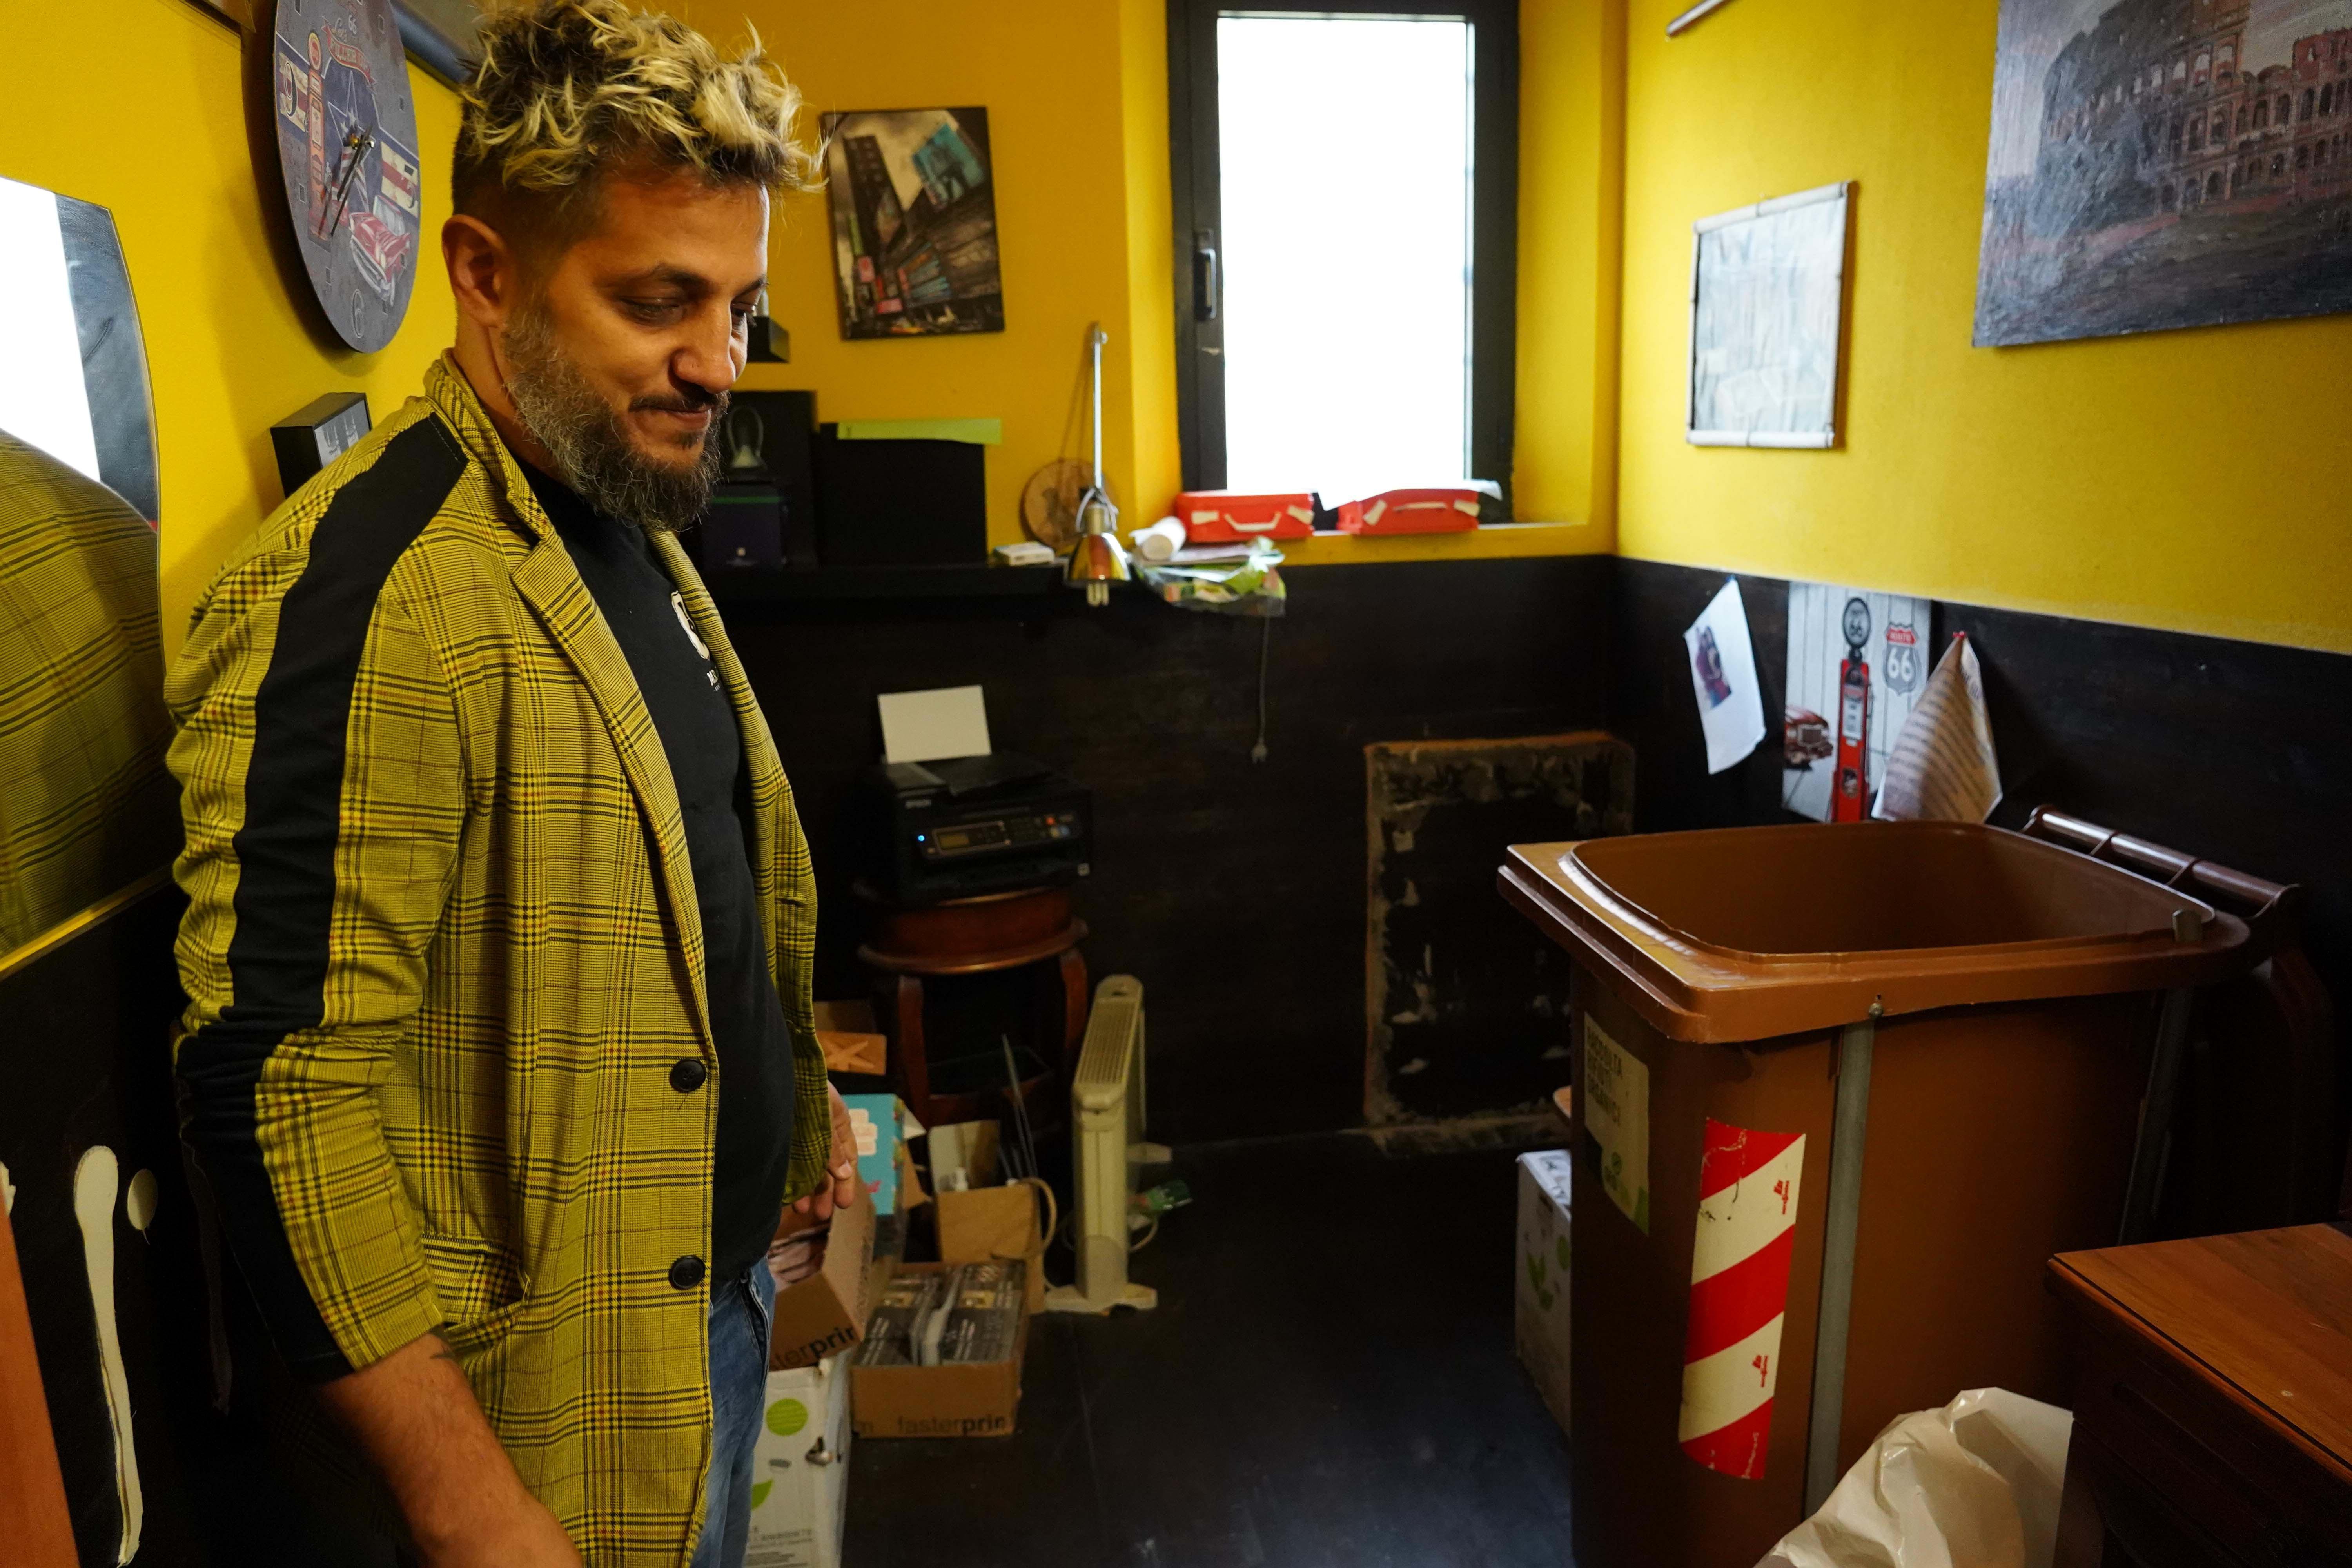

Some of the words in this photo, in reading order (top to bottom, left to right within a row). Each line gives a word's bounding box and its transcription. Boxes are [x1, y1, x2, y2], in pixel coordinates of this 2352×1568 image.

[348, 14, 357, 35] 66
[283, 61, 298, 118] 9
[351, 288, 365, 338] 6
[1889, 632, 1911, 642] ROUTE
[1887, 647, 1912, 682] 66
